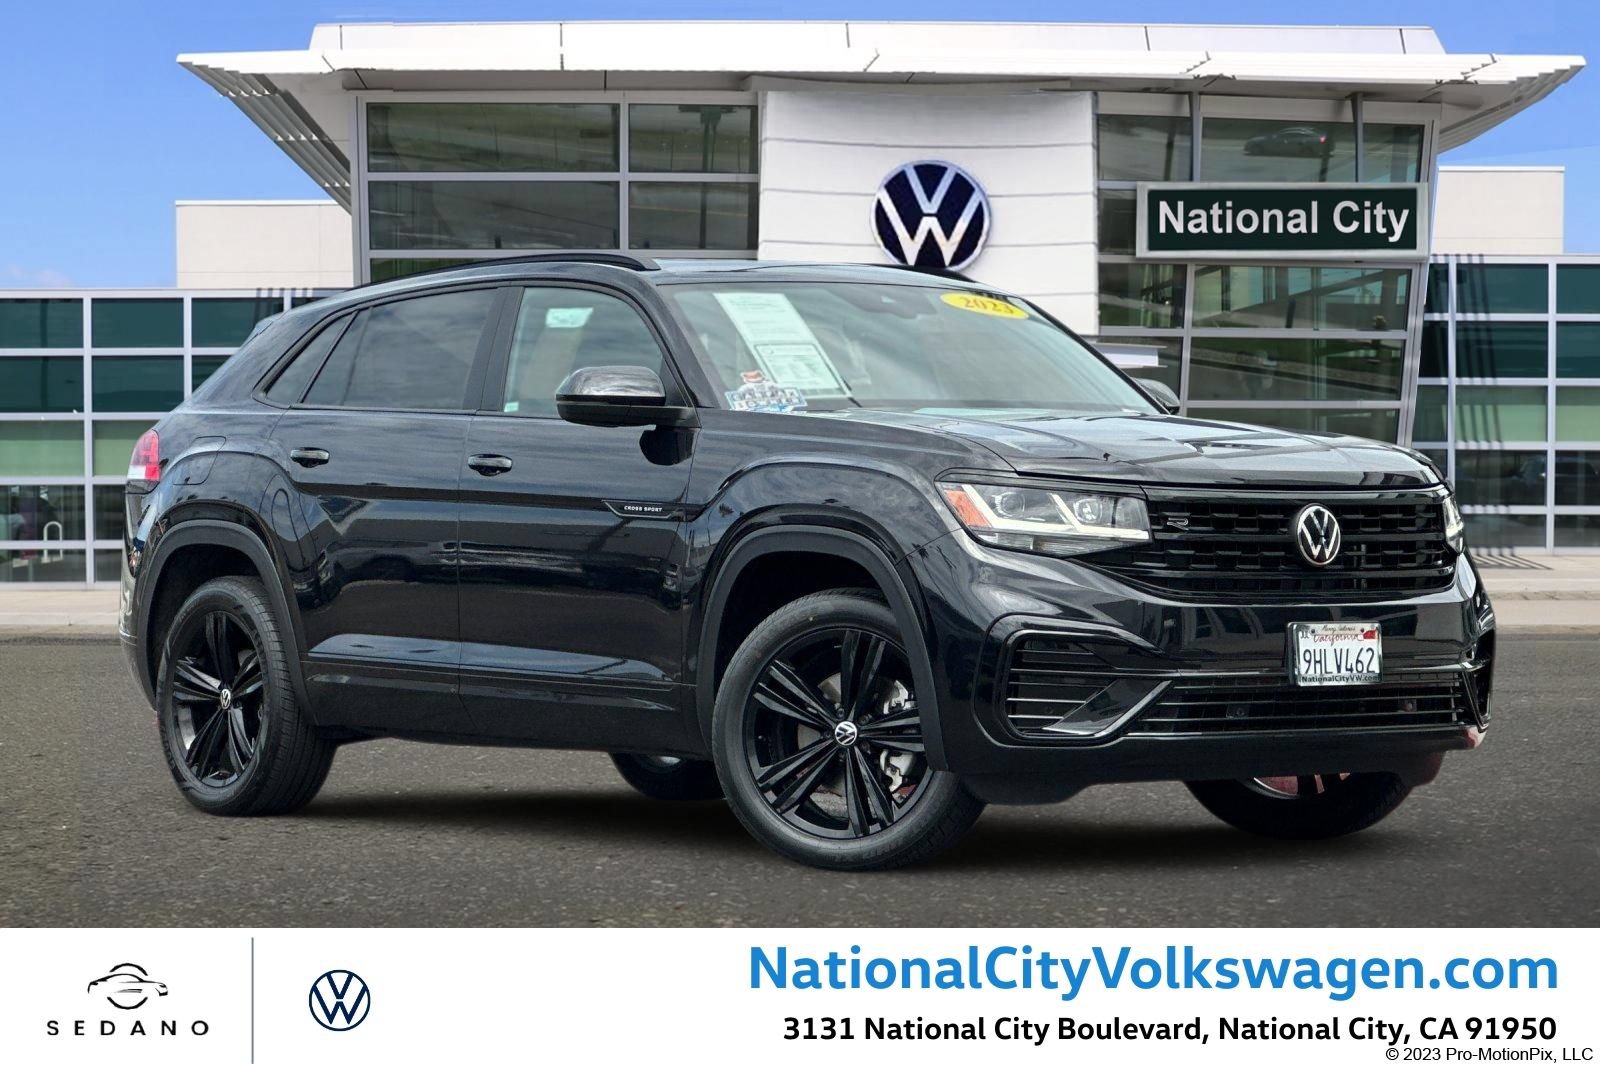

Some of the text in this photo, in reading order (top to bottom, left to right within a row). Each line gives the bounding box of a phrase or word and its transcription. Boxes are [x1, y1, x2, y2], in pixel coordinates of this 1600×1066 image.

[1158, 200, 1409, 242] National City
[960, 296, 1014, 315] 2023
[1303, 647, 1376, 675] 9HLV462
